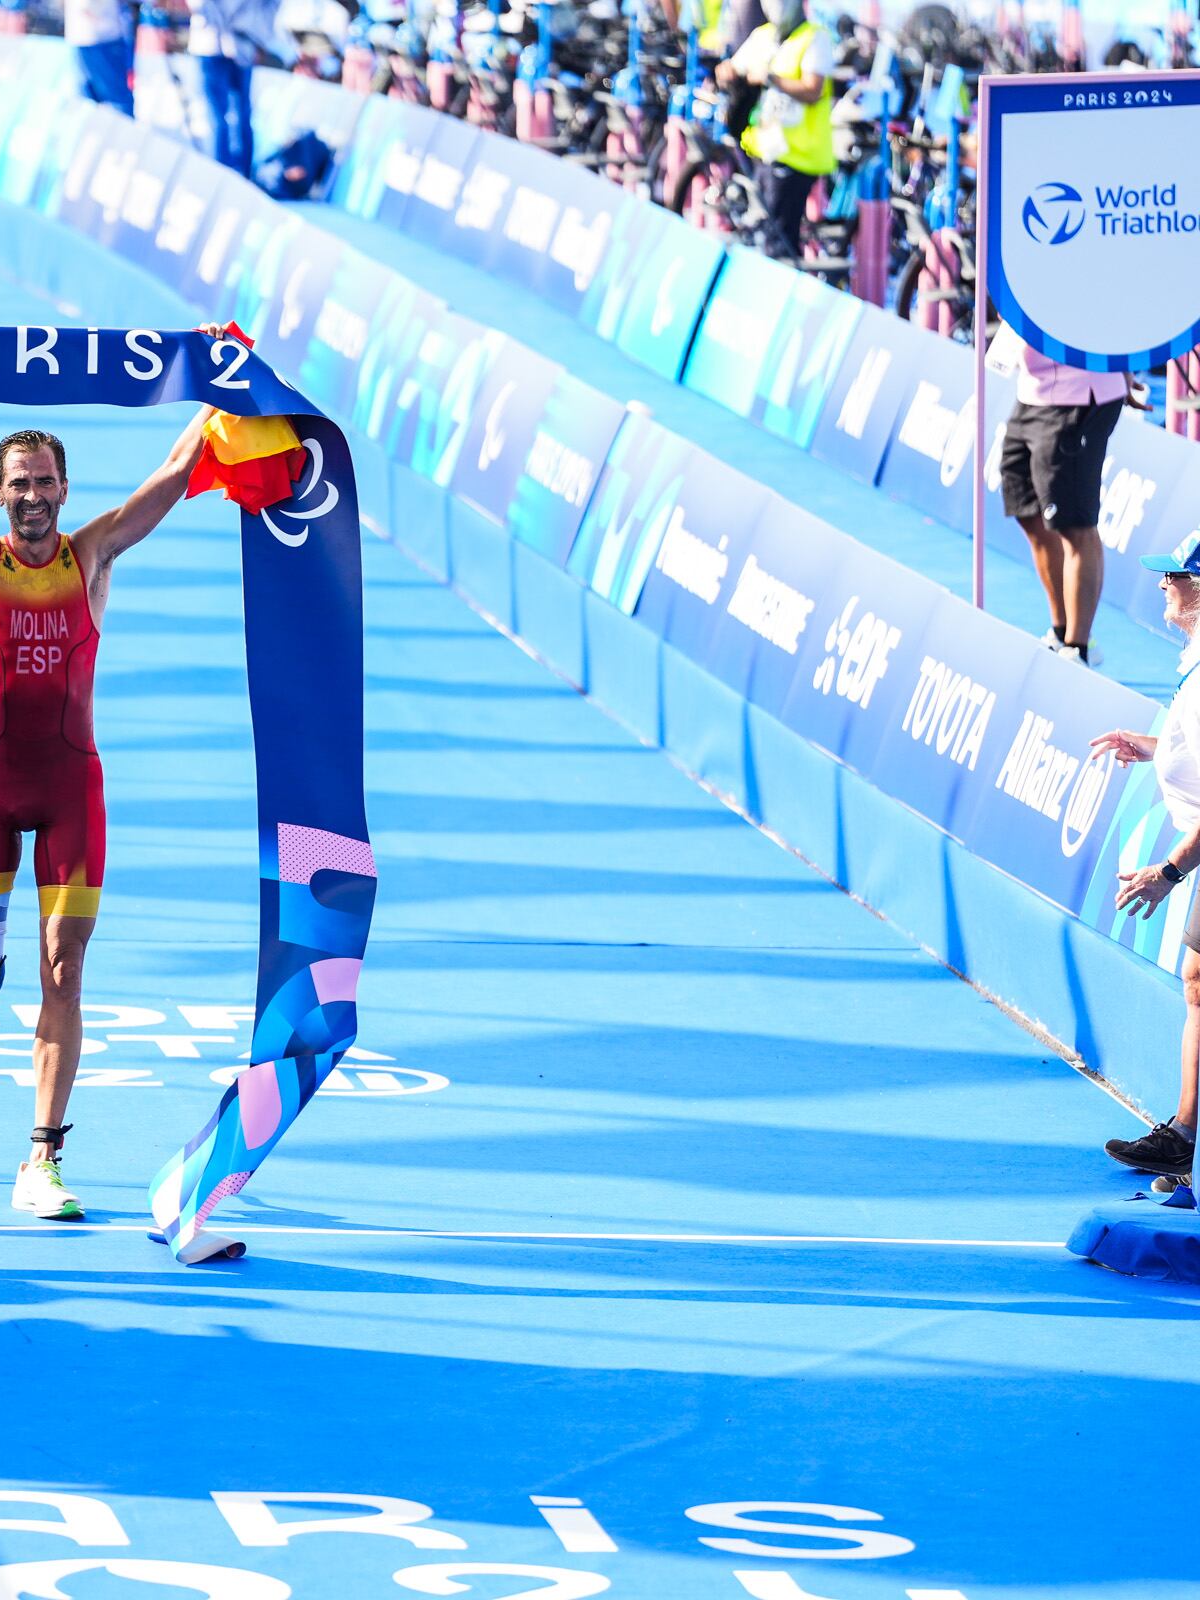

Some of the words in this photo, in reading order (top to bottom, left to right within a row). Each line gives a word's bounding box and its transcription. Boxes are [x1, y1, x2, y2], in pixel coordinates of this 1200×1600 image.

[1123, 89, 1173, 105] 2024
[1095, 183, 1176, 209] World
[1095, 210, 1200, 235] Triathlo
[9, 609, 69, 640] MOLINA
[15, 645, 62, 674] ESP
[902, 656, 997, 771] TOYOTA
[995, 709, 1080, 822] Allianz
